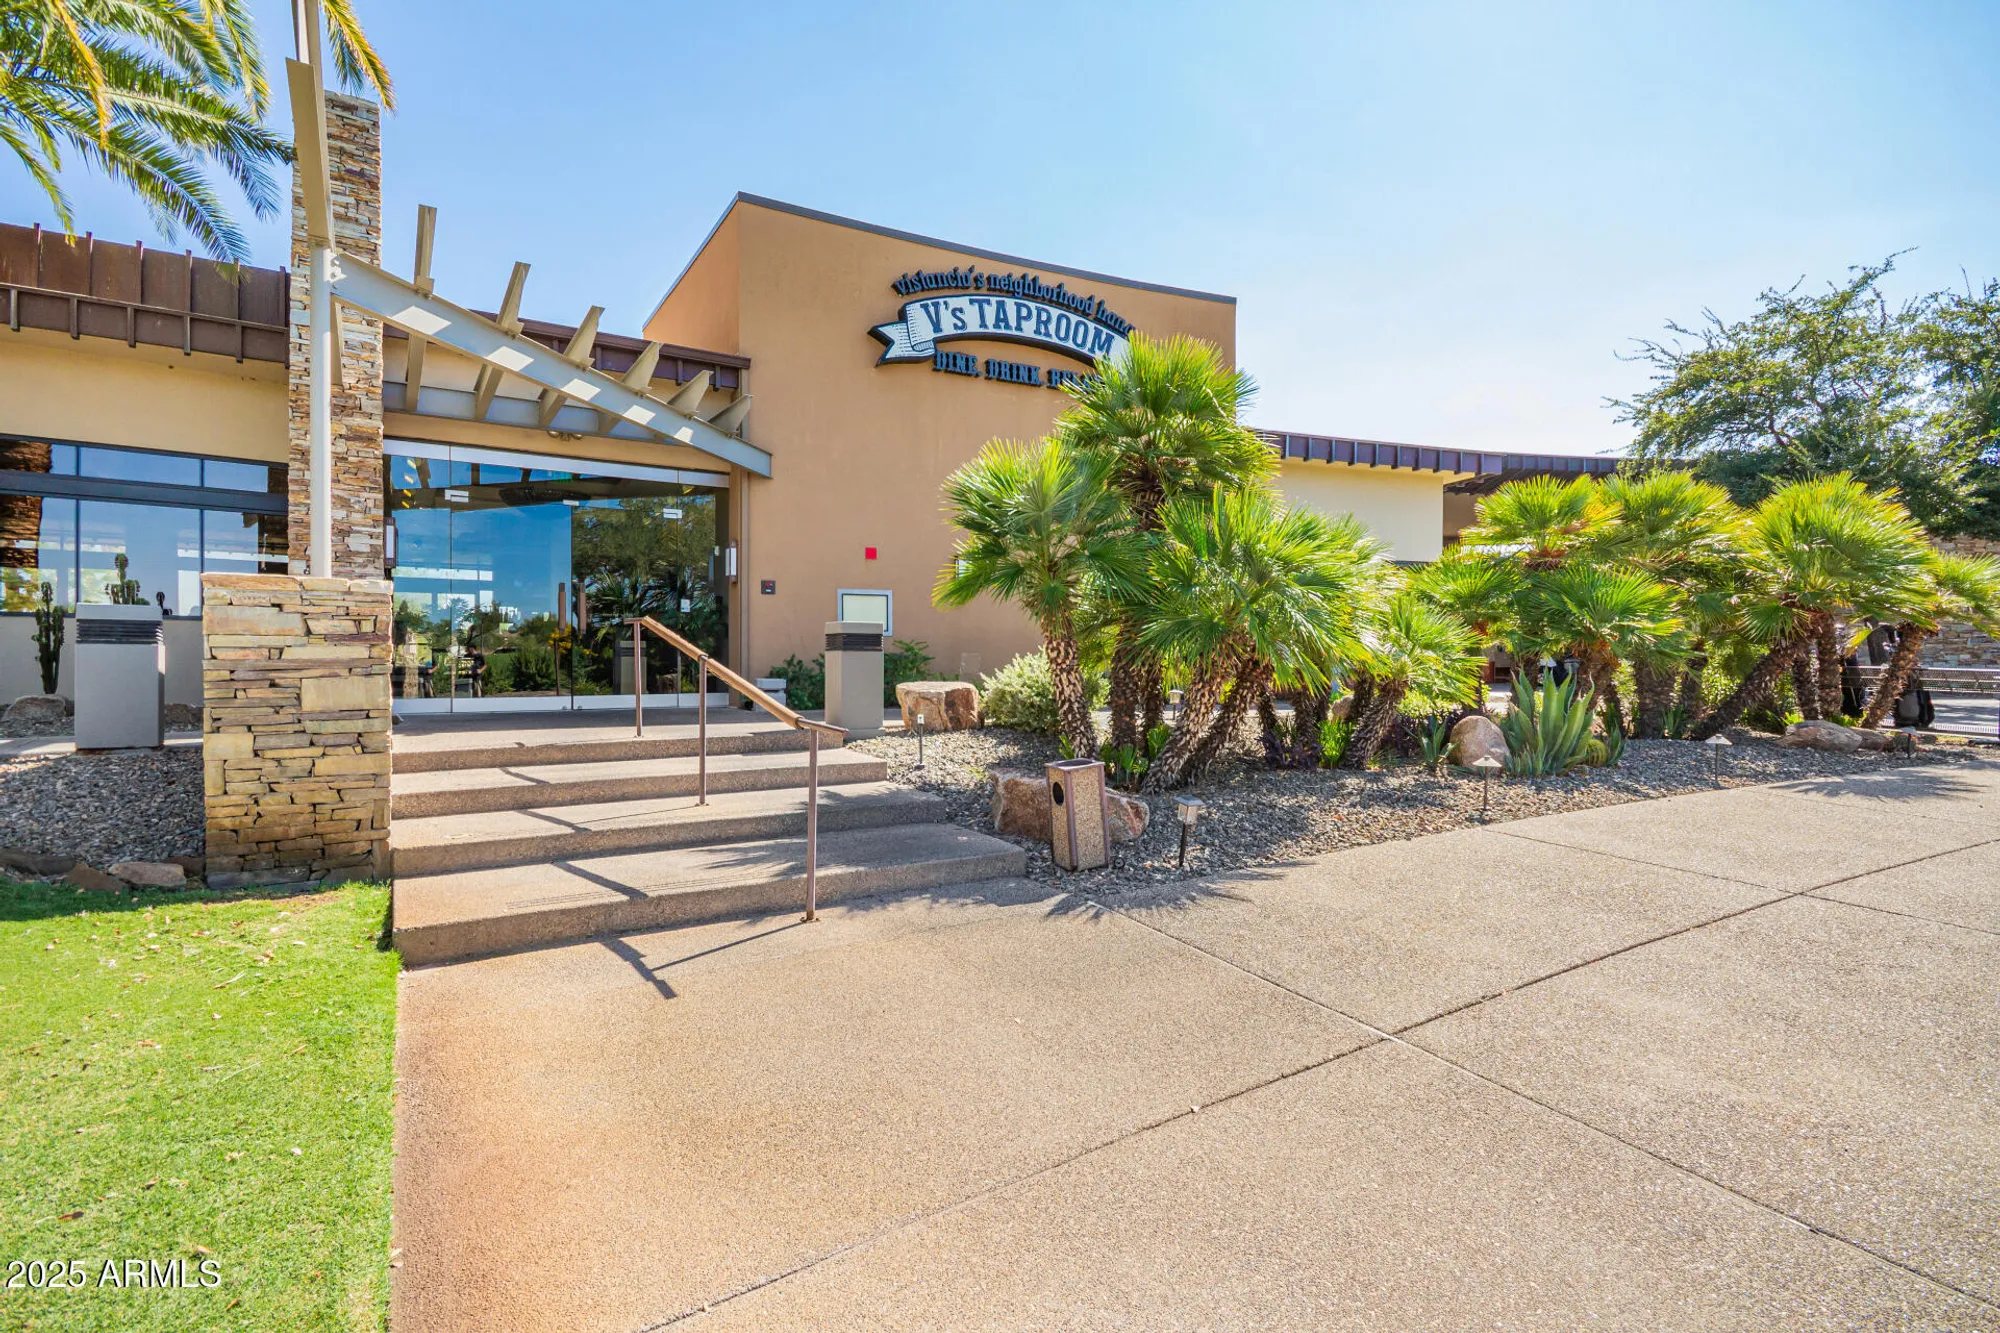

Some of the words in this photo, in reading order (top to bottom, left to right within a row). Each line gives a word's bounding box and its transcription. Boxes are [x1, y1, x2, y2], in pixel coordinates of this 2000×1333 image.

[893, 265, 985, 295] vistancia's
[986, 272, 1095, 317] neighborhood
[920, 300, 966, 334] V's
[969, 298, 1115, 359] TAPROOM
